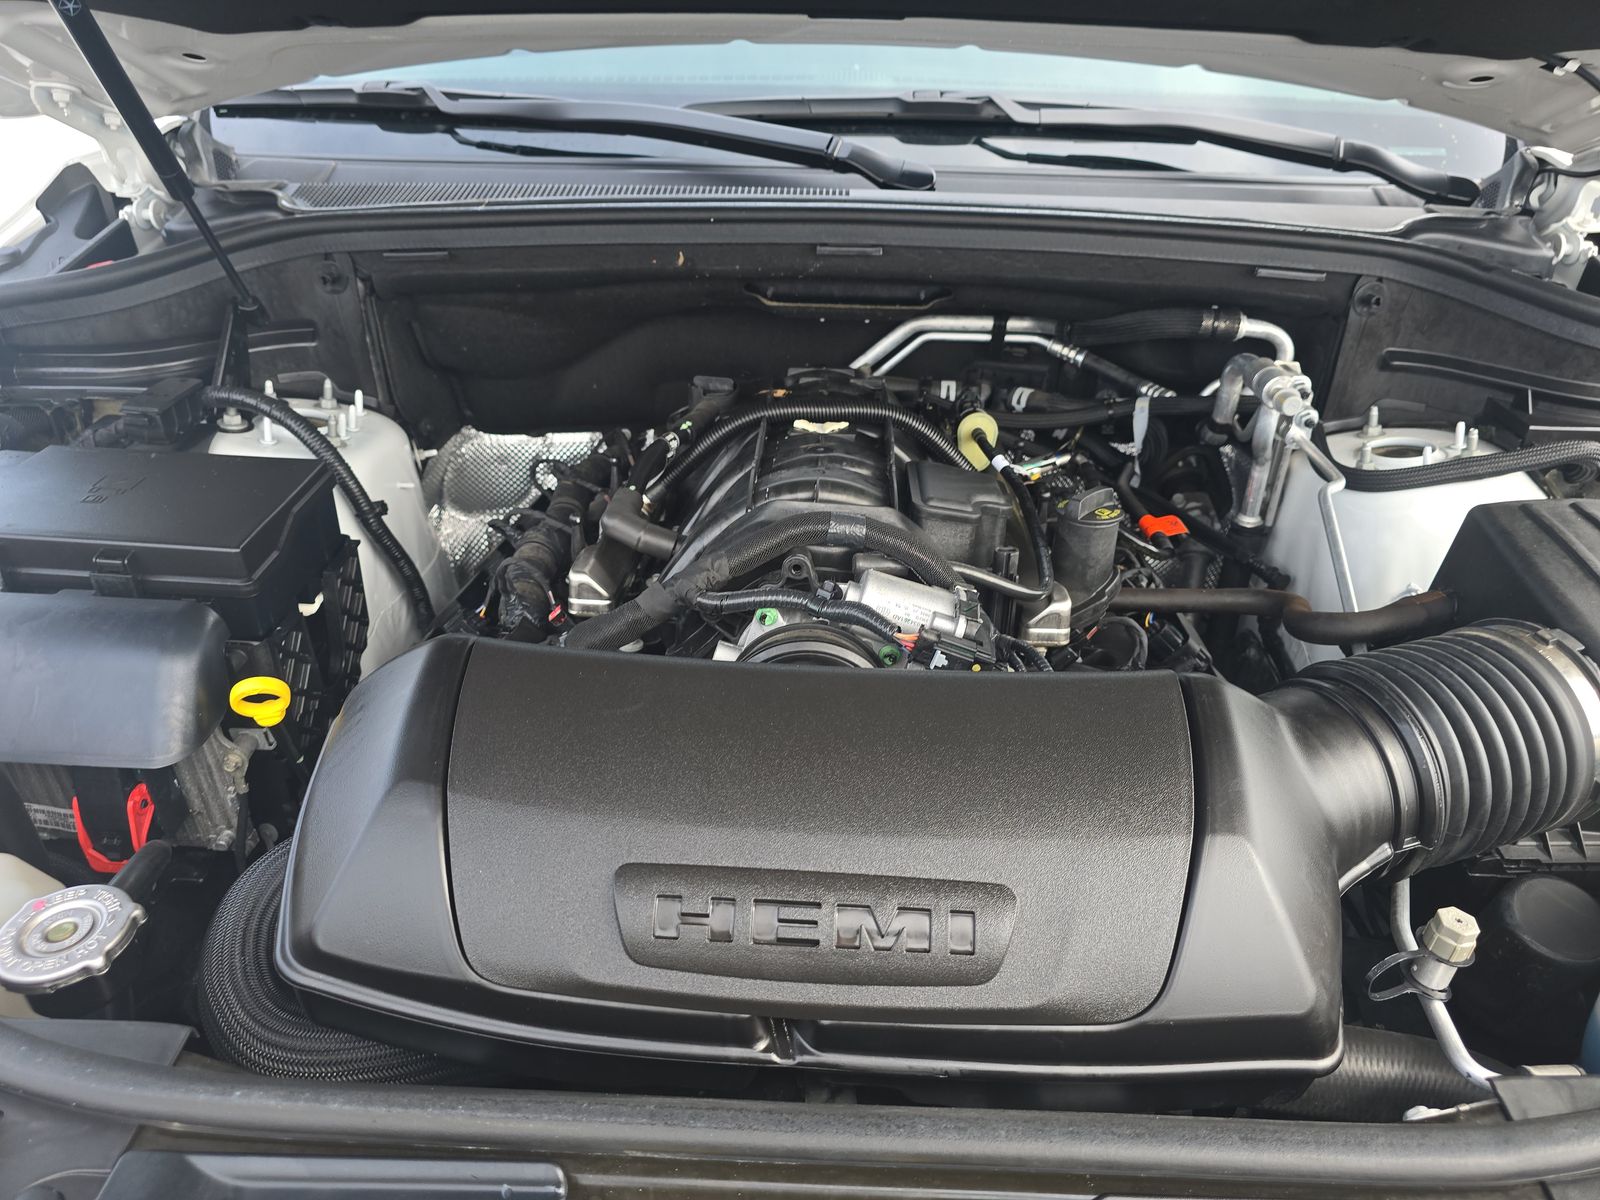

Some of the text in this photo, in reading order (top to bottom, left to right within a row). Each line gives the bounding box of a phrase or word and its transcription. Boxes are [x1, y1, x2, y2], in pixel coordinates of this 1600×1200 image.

[94, 889, 122, 912] TIGHT
[652, 894, 975, 956] HEMI
[21, 954, 69, 973] OPEN
[76, 931, 107, 959] HOT
